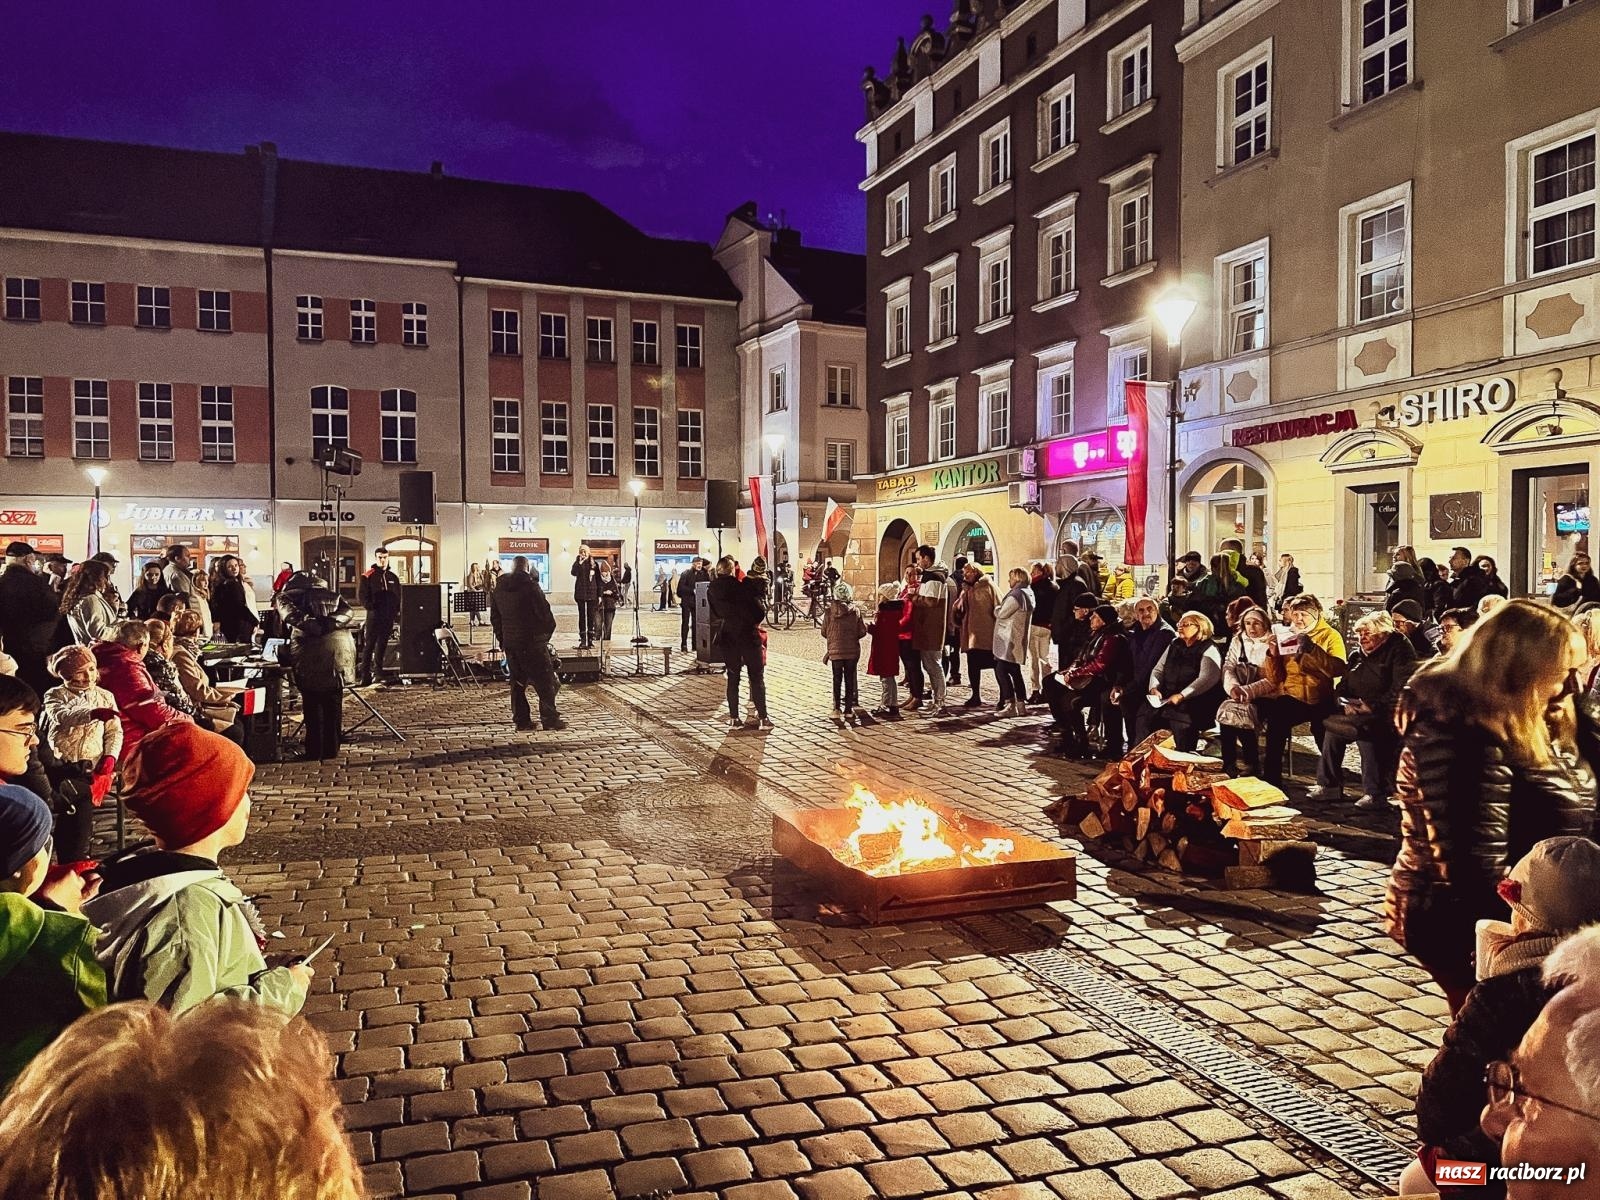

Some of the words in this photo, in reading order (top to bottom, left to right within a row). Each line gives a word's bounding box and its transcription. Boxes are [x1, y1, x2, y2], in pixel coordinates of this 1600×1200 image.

[1400, 377, 1516, 426] SHIRO
[1232, 409, 1358, 447] RESTAURACJA
[933, 460, 1001, 490] KANTOR
[118, 503, 216, 521] JUBILER
